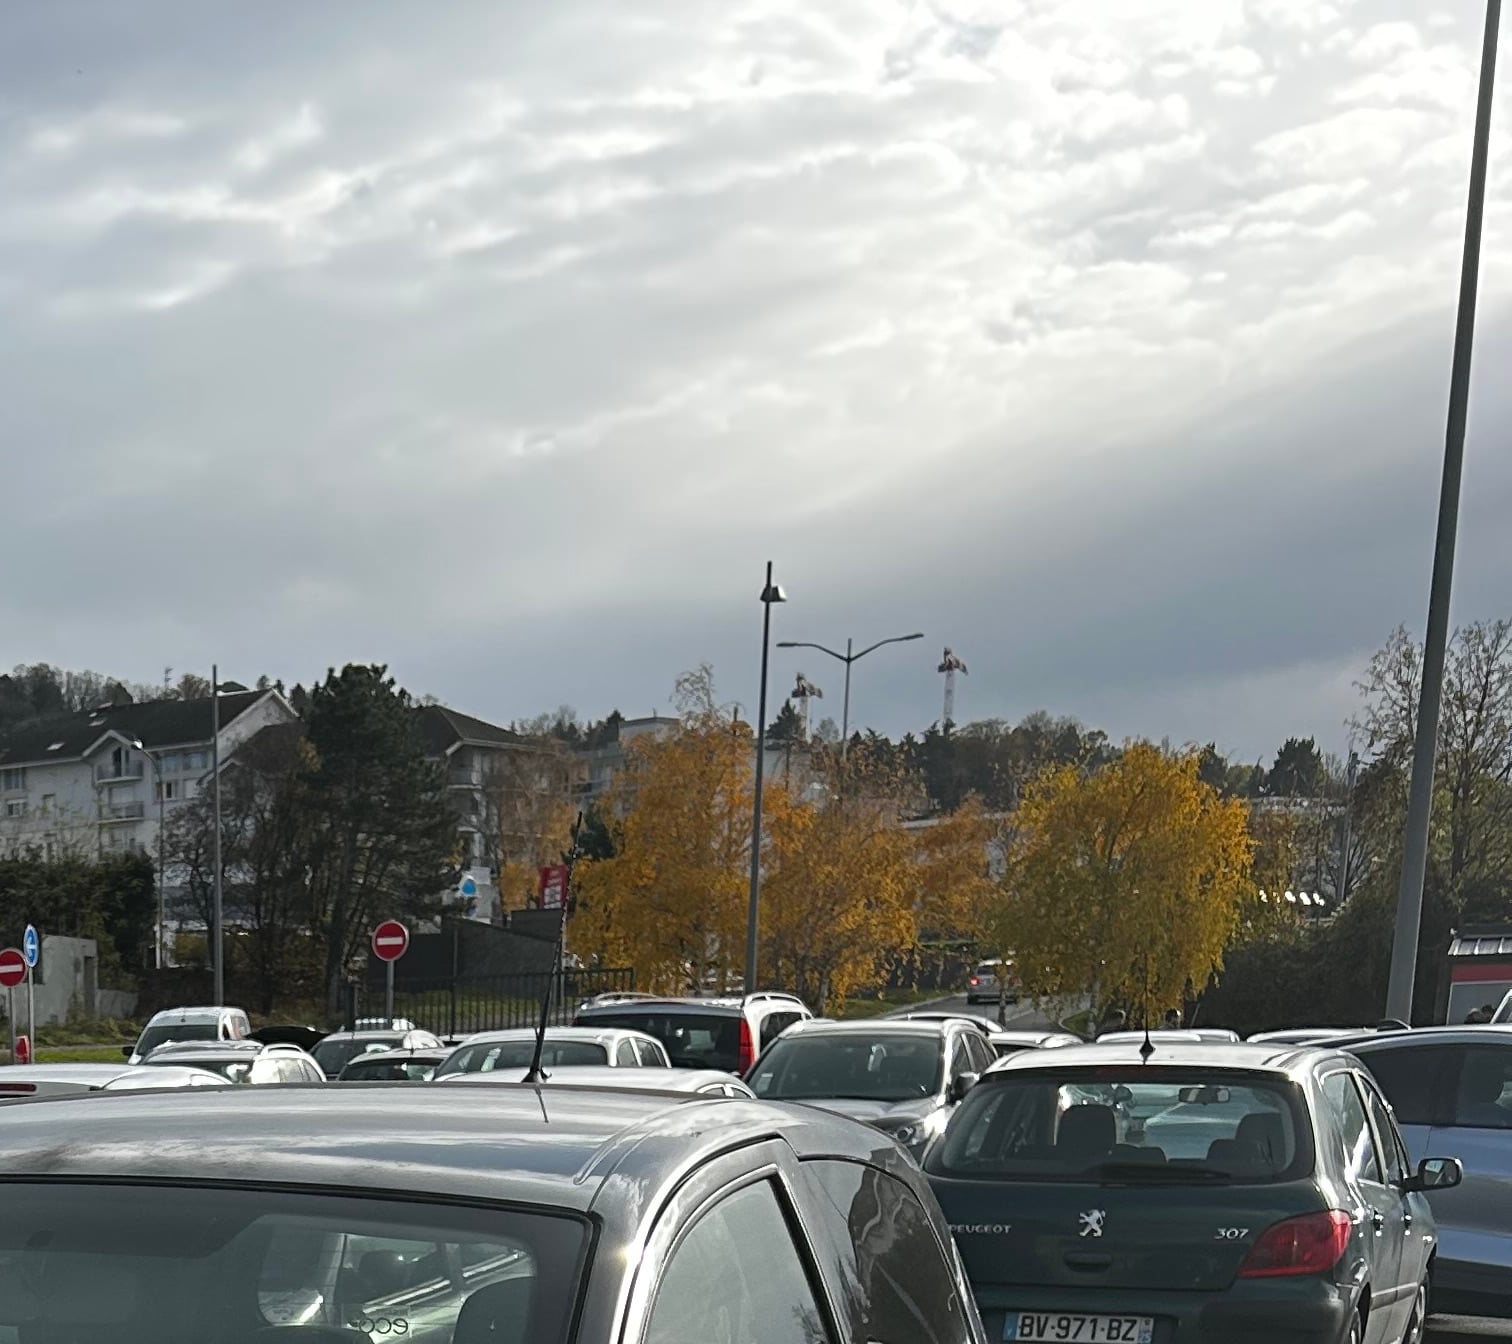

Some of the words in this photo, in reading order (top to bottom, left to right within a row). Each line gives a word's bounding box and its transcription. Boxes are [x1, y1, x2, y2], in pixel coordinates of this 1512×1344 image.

[947, 1224, 1011, 1234] PEUGEOT
[1215, 1227, 1249, 1240] 307
[1019, 1315, 1137, 1342] BV-971-BZ
